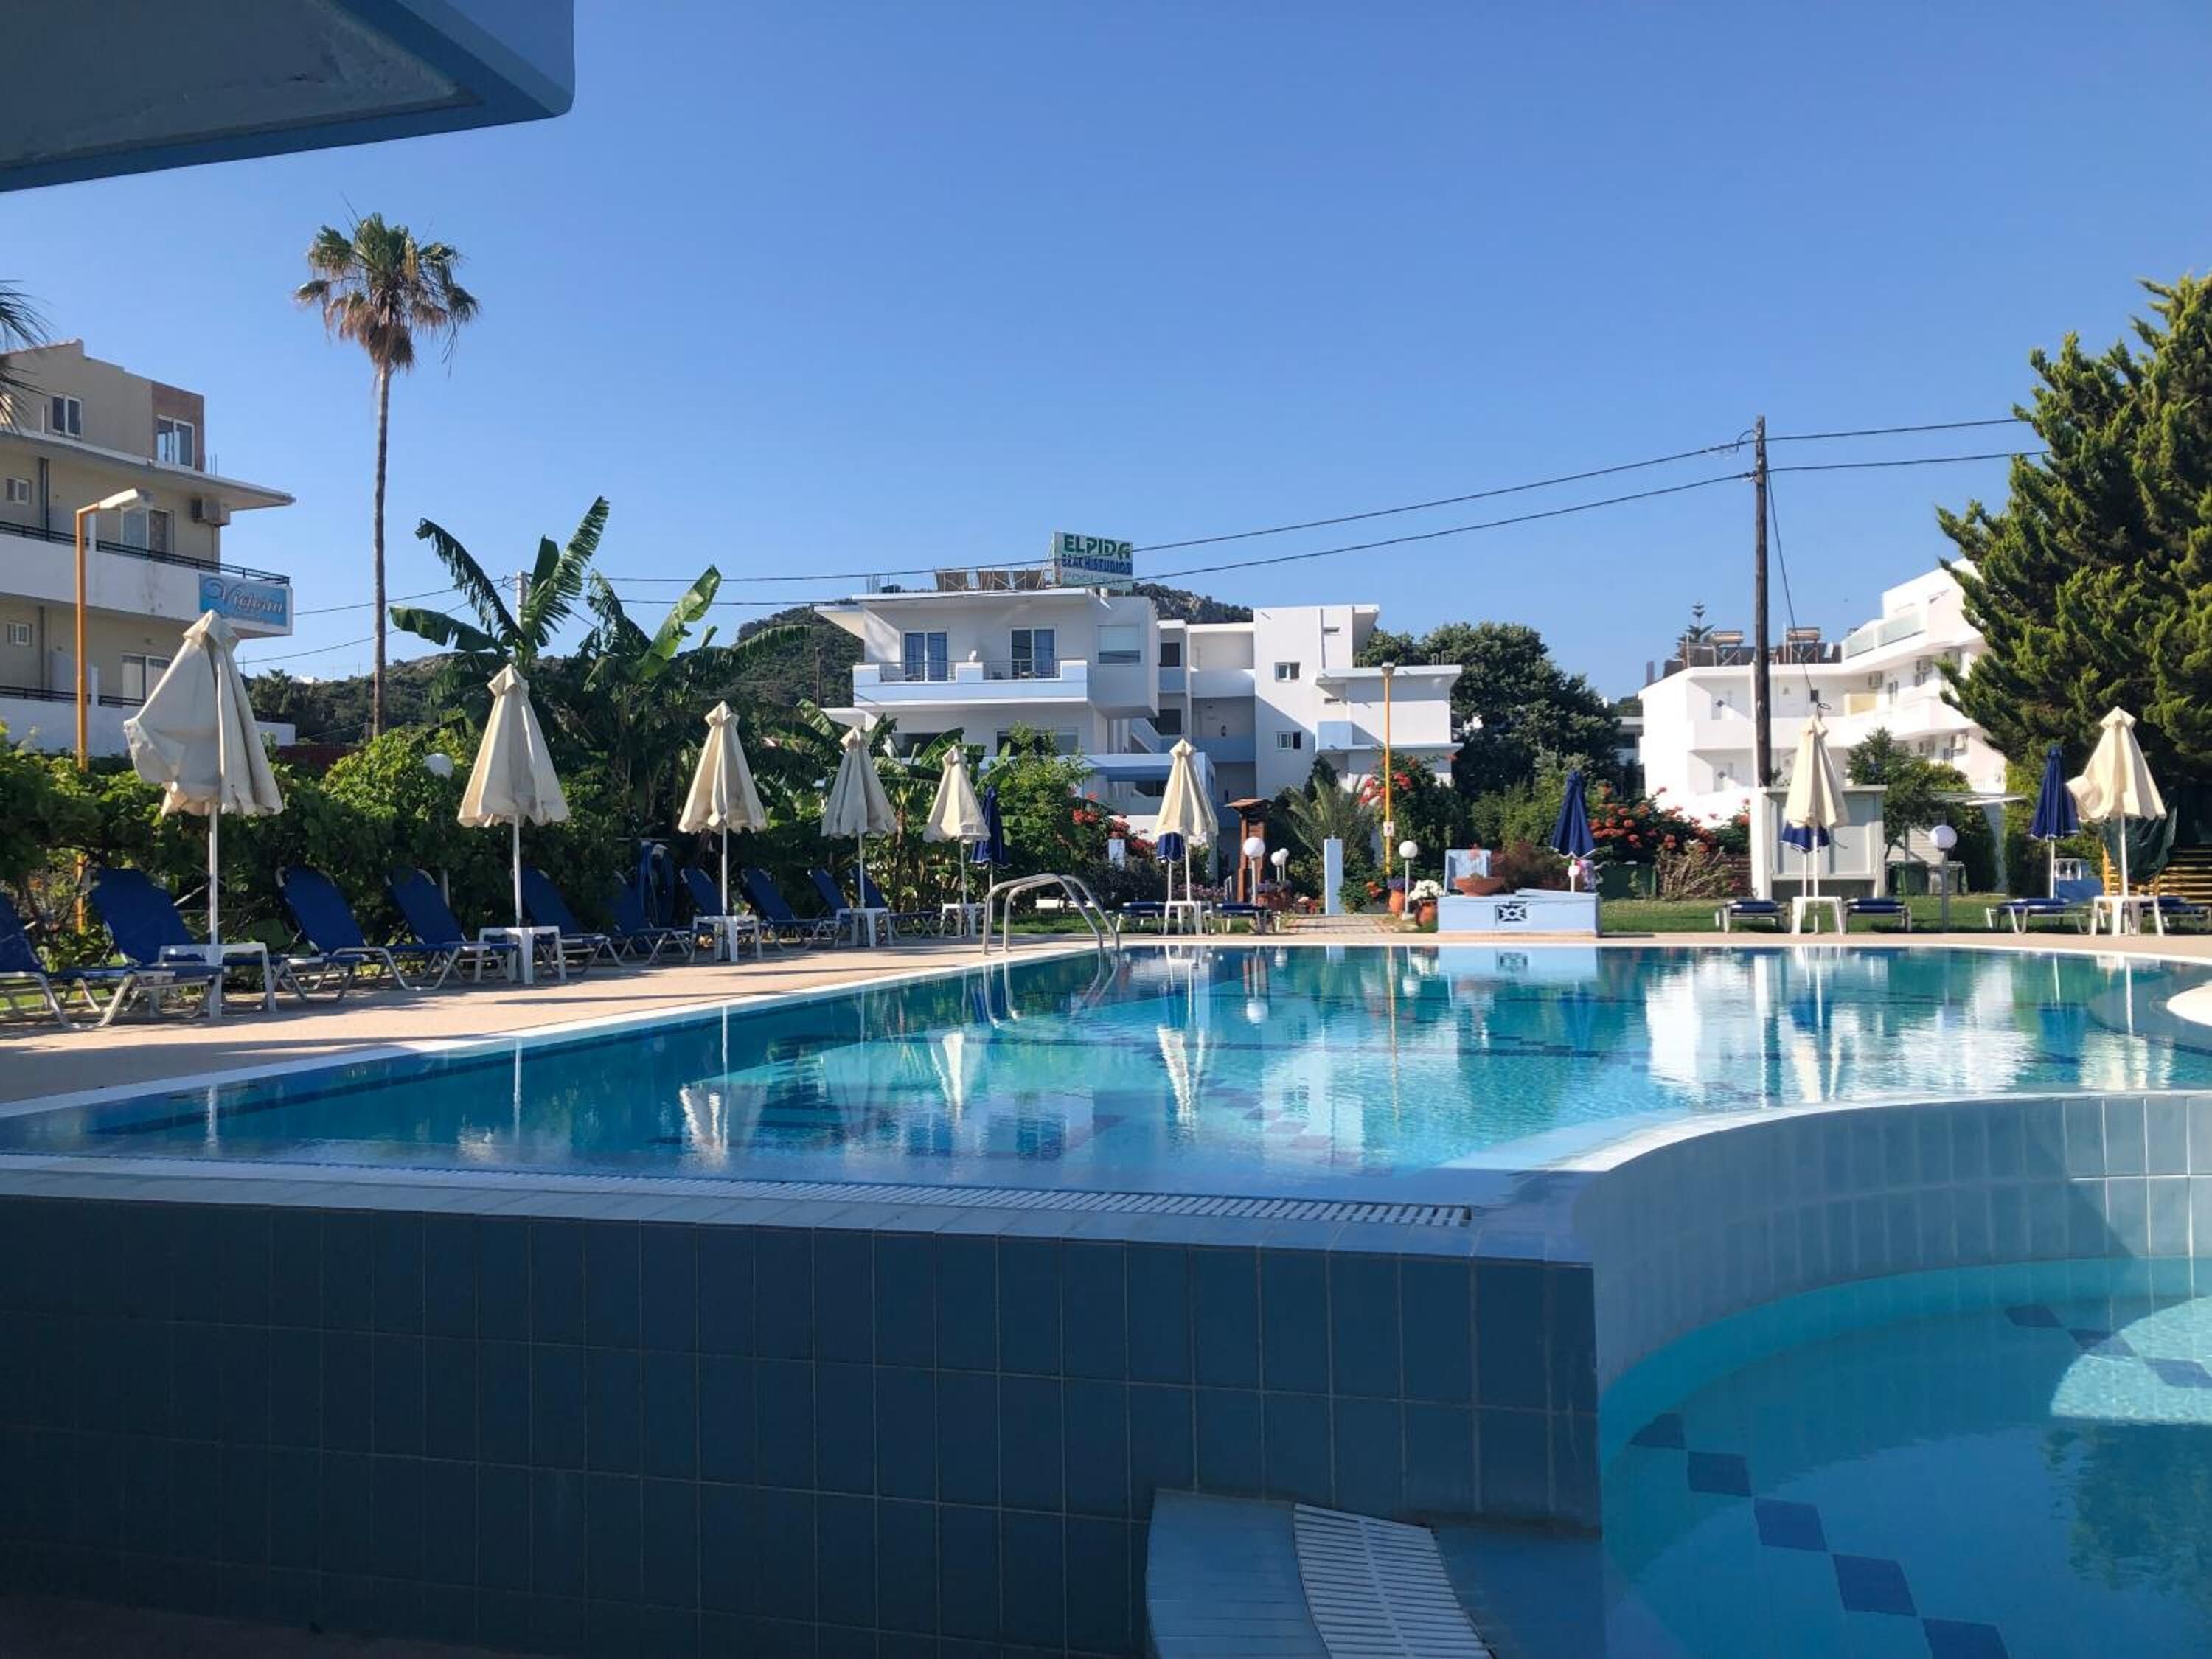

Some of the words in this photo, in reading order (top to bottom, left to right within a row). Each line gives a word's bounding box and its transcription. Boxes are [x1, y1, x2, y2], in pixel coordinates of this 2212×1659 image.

[1064, 535, 1130, 559] ELPIDA
[1062, 554, 1091, 570] BEACH
[1093, 558, 1132, 574] STUDIOS
